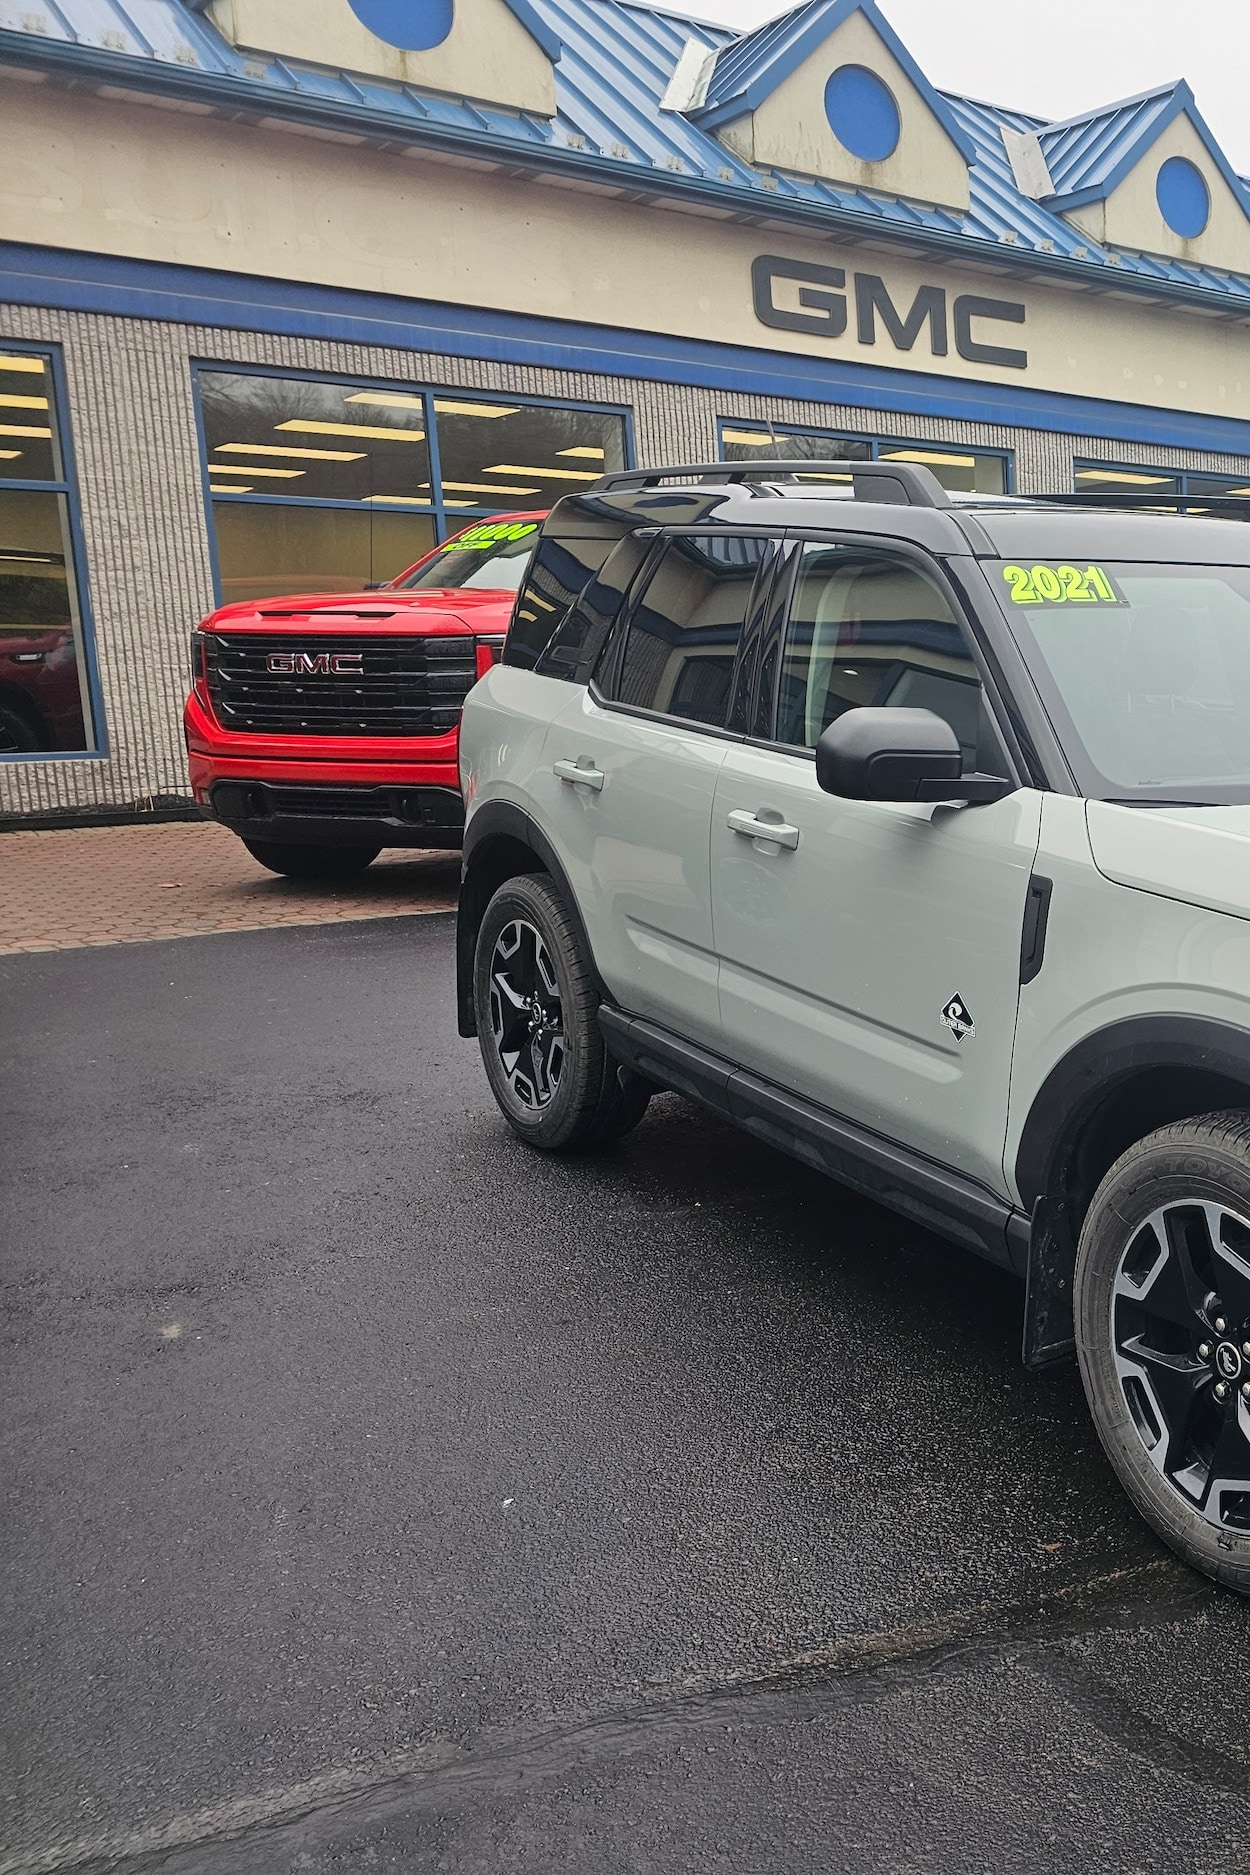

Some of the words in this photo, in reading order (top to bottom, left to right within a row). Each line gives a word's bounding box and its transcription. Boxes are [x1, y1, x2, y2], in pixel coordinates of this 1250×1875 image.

[751, 255, 1027, 369] GMC
[1003, 565, 1117, 604] 2021
[266, 653, 364, 675] GMC
